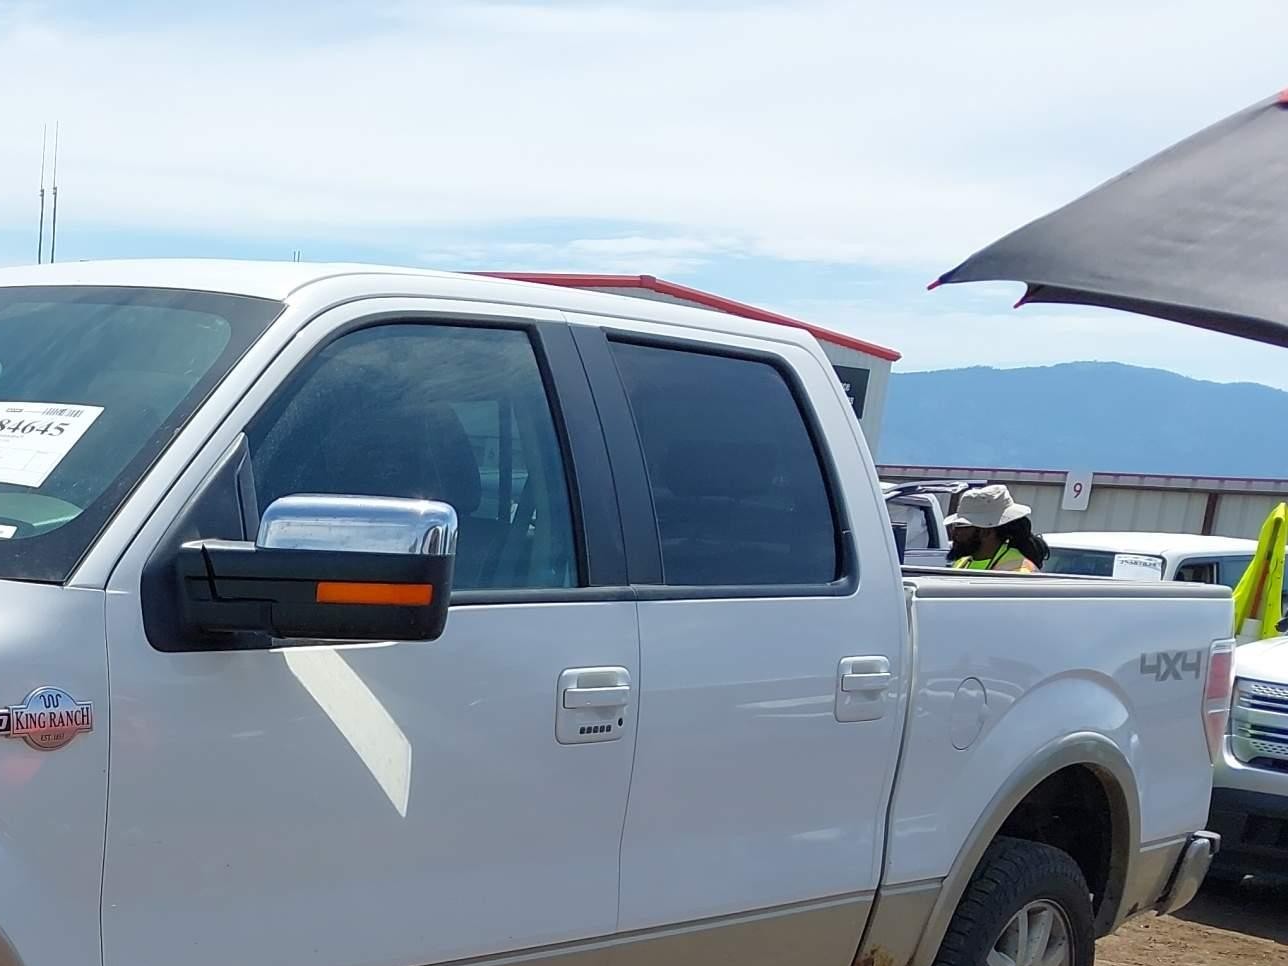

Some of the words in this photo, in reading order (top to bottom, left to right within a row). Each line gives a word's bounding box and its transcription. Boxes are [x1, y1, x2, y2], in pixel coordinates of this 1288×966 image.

[1073, 482, 1083, 499] 9
[15, 711, 46, 731] KING
[49, 706, 90, 728] RANCH
